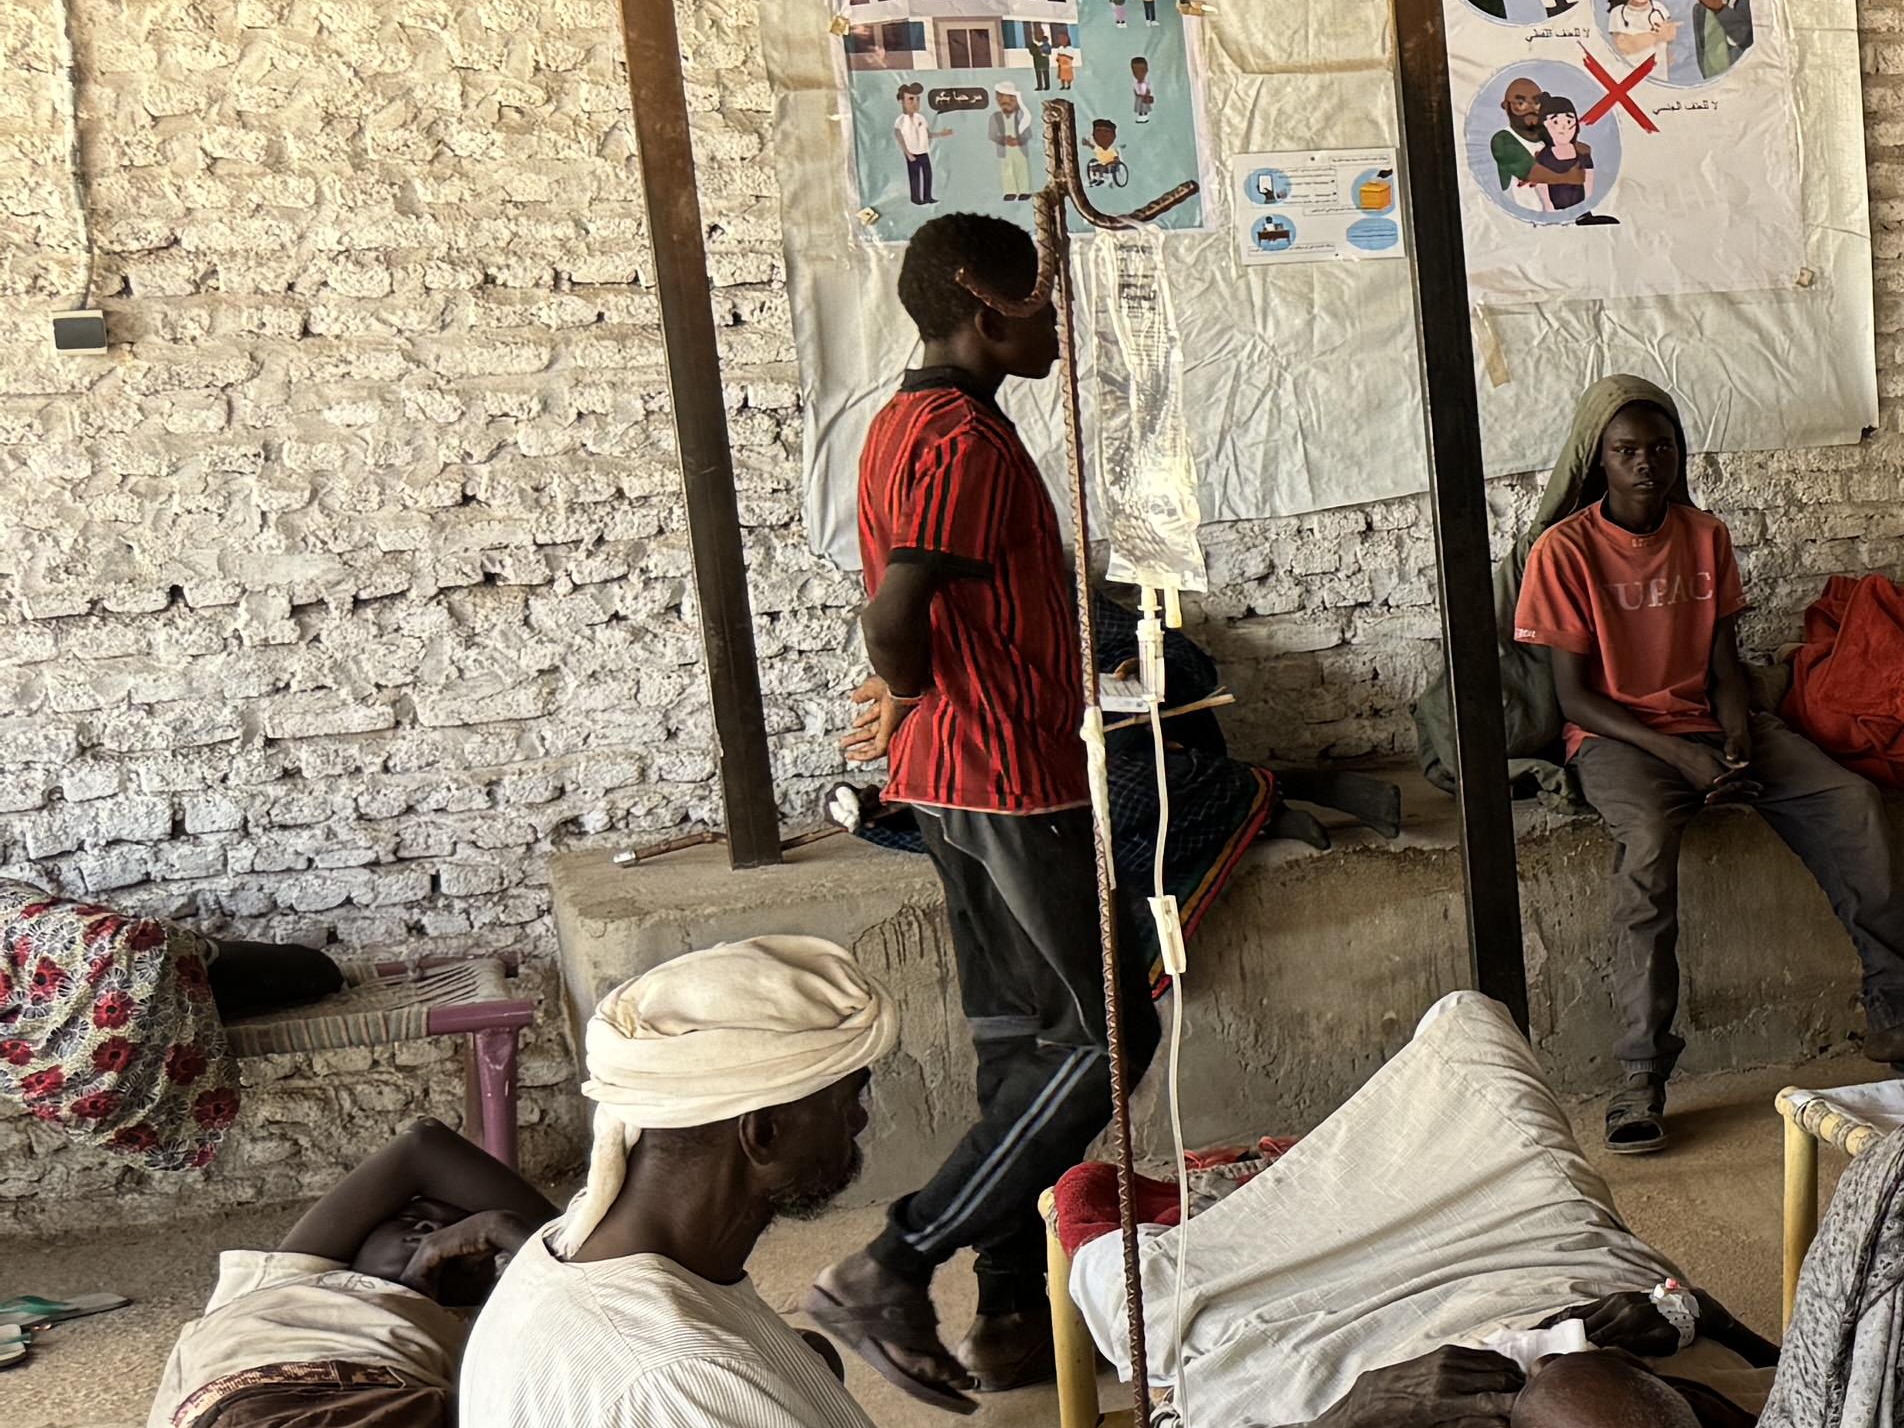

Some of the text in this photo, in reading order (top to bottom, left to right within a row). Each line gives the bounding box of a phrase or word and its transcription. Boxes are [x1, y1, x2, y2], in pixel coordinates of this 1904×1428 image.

[1582, 27, 1591, 39] لا
[952, 90, 984, 105] مرحبا
[1711, 99, 1719, 111] لا
